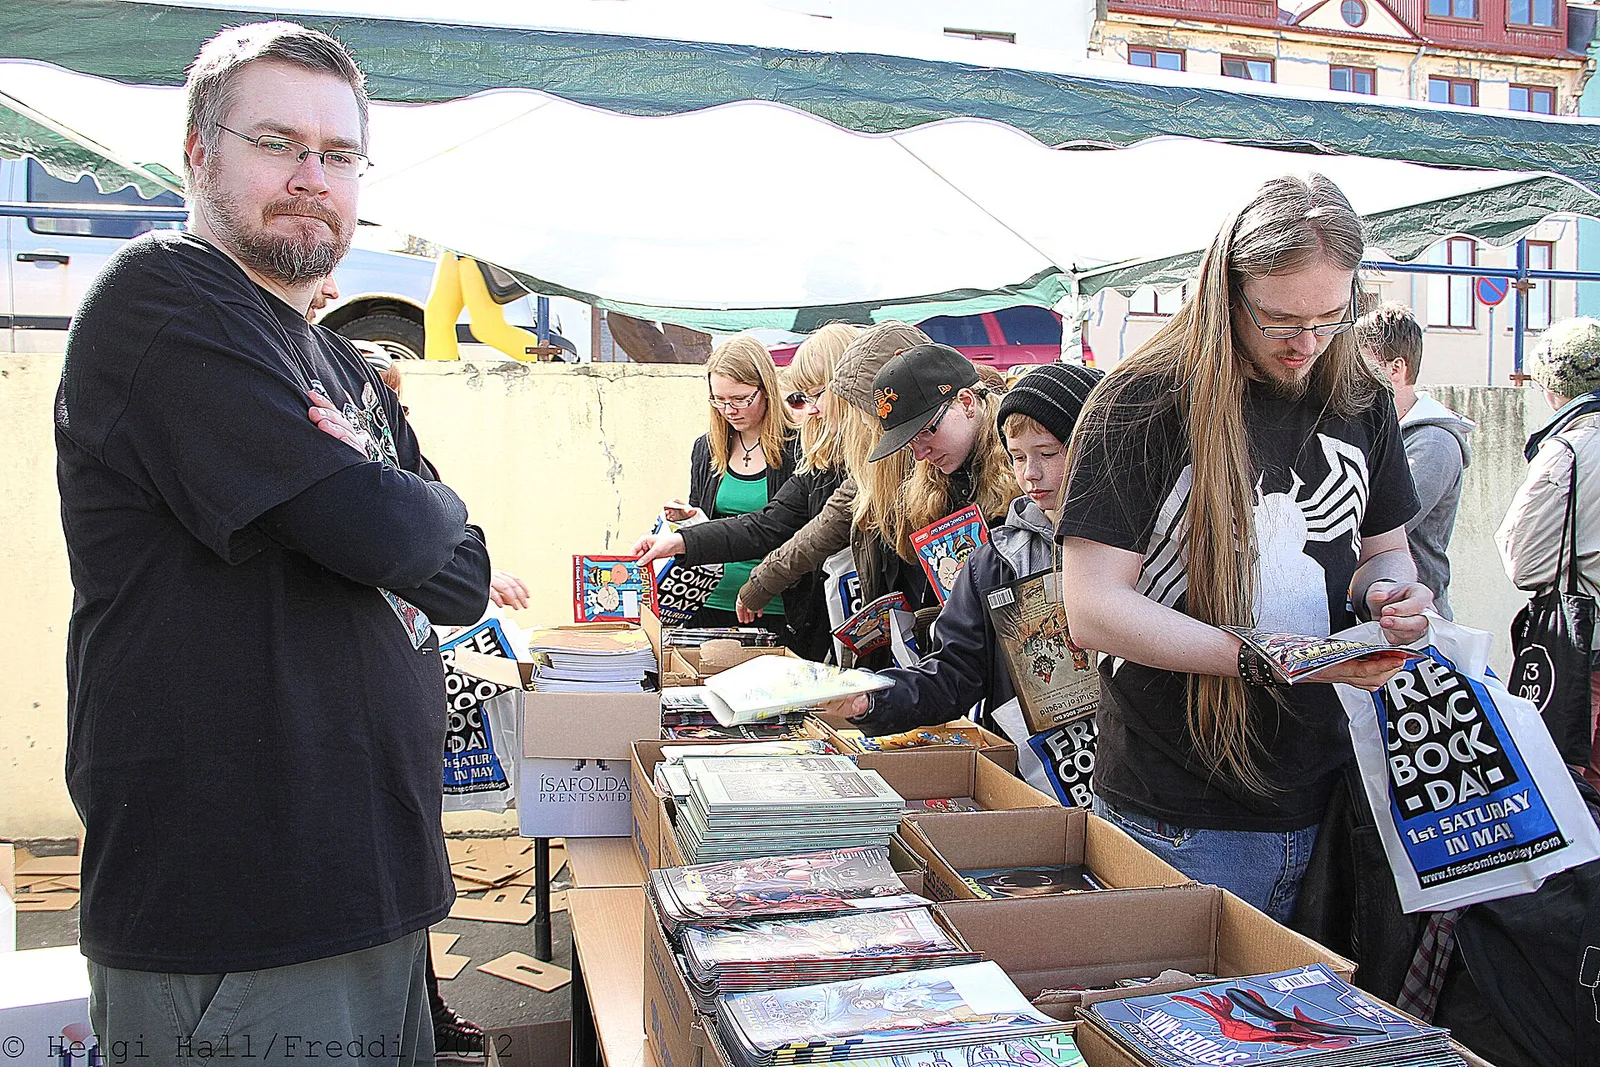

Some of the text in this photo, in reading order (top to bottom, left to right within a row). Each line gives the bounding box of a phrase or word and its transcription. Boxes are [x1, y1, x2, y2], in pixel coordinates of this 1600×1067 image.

[660, 577, 712, 603] BOOK
[660, 594, 696, 611] DAY
[1040, 702, 1067, 717] Legend
[1063, 709, 1077, 718] BOOK
[452, 754, 493, 769] SATUR
[454, 766, 494, 781] IN MAY
[1407, 823, 1438, 845] 1st
[1445, 834, 1470, 856] IN
[1145, 1009, 1251, 1066] SPIDER-MAN
